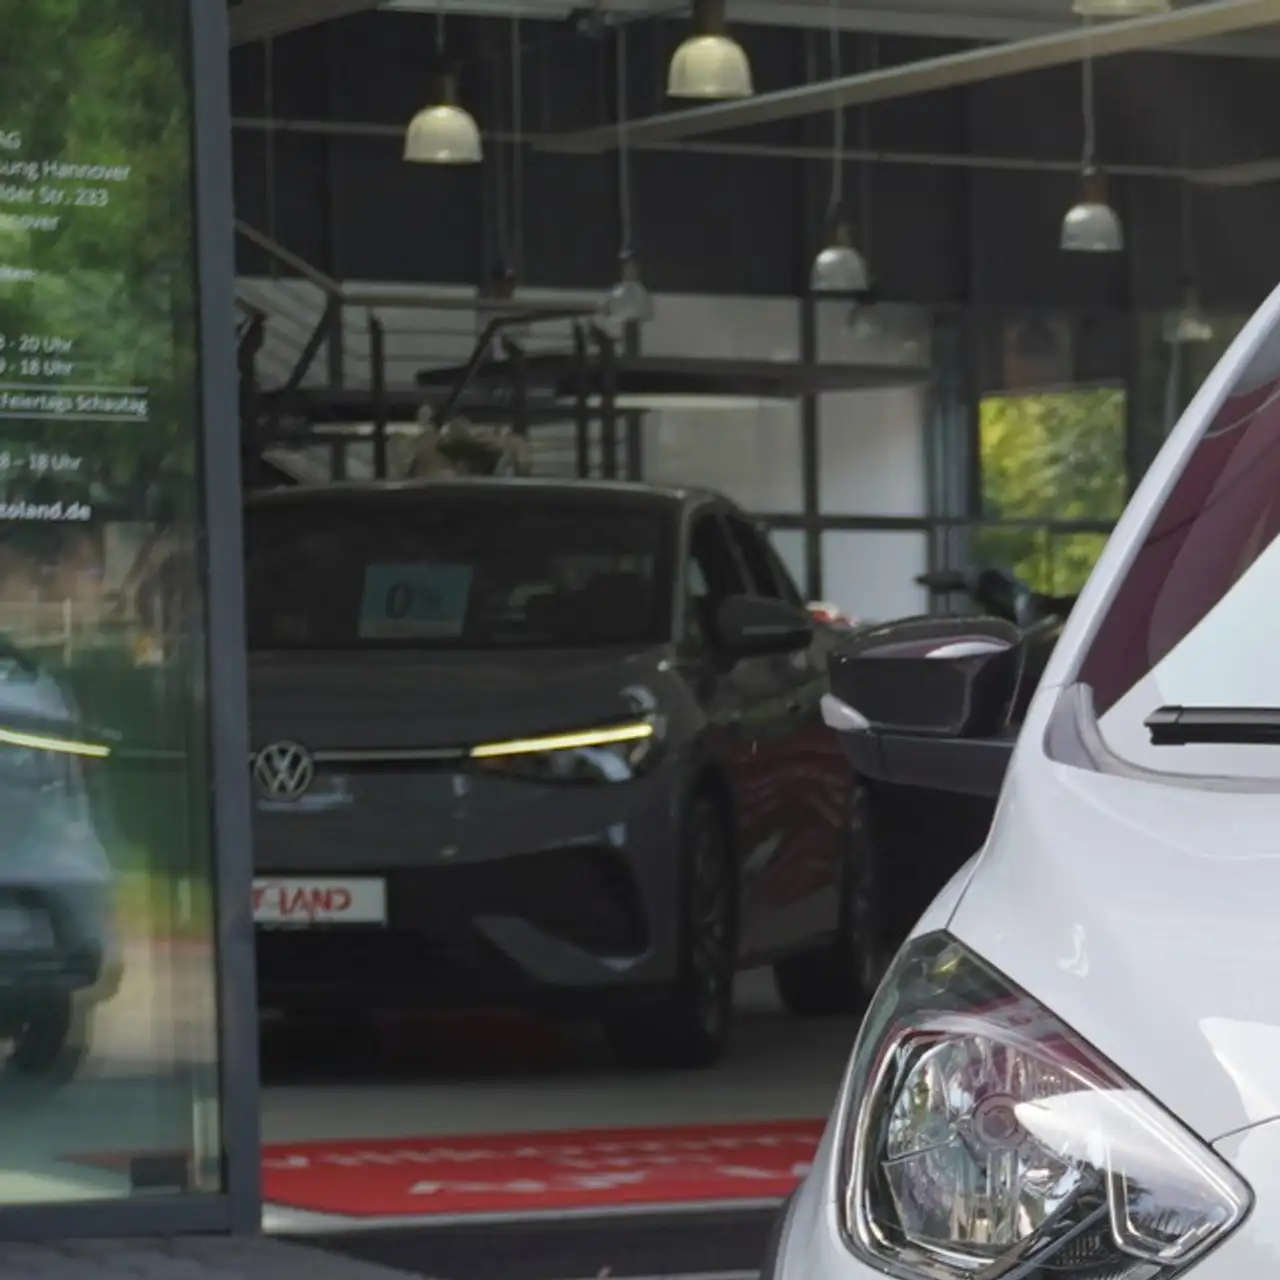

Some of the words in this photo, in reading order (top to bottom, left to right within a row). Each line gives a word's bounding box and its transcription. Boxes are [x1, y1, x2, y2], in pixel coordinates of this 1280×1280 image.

[42, 160, 131, 181] Hannover
[19, 333, 40, 352] 20
[43, 335, 72, 354] Uhr
[20, 357, 40, 375] 18
[43, 359, 72, 376] Uhr
